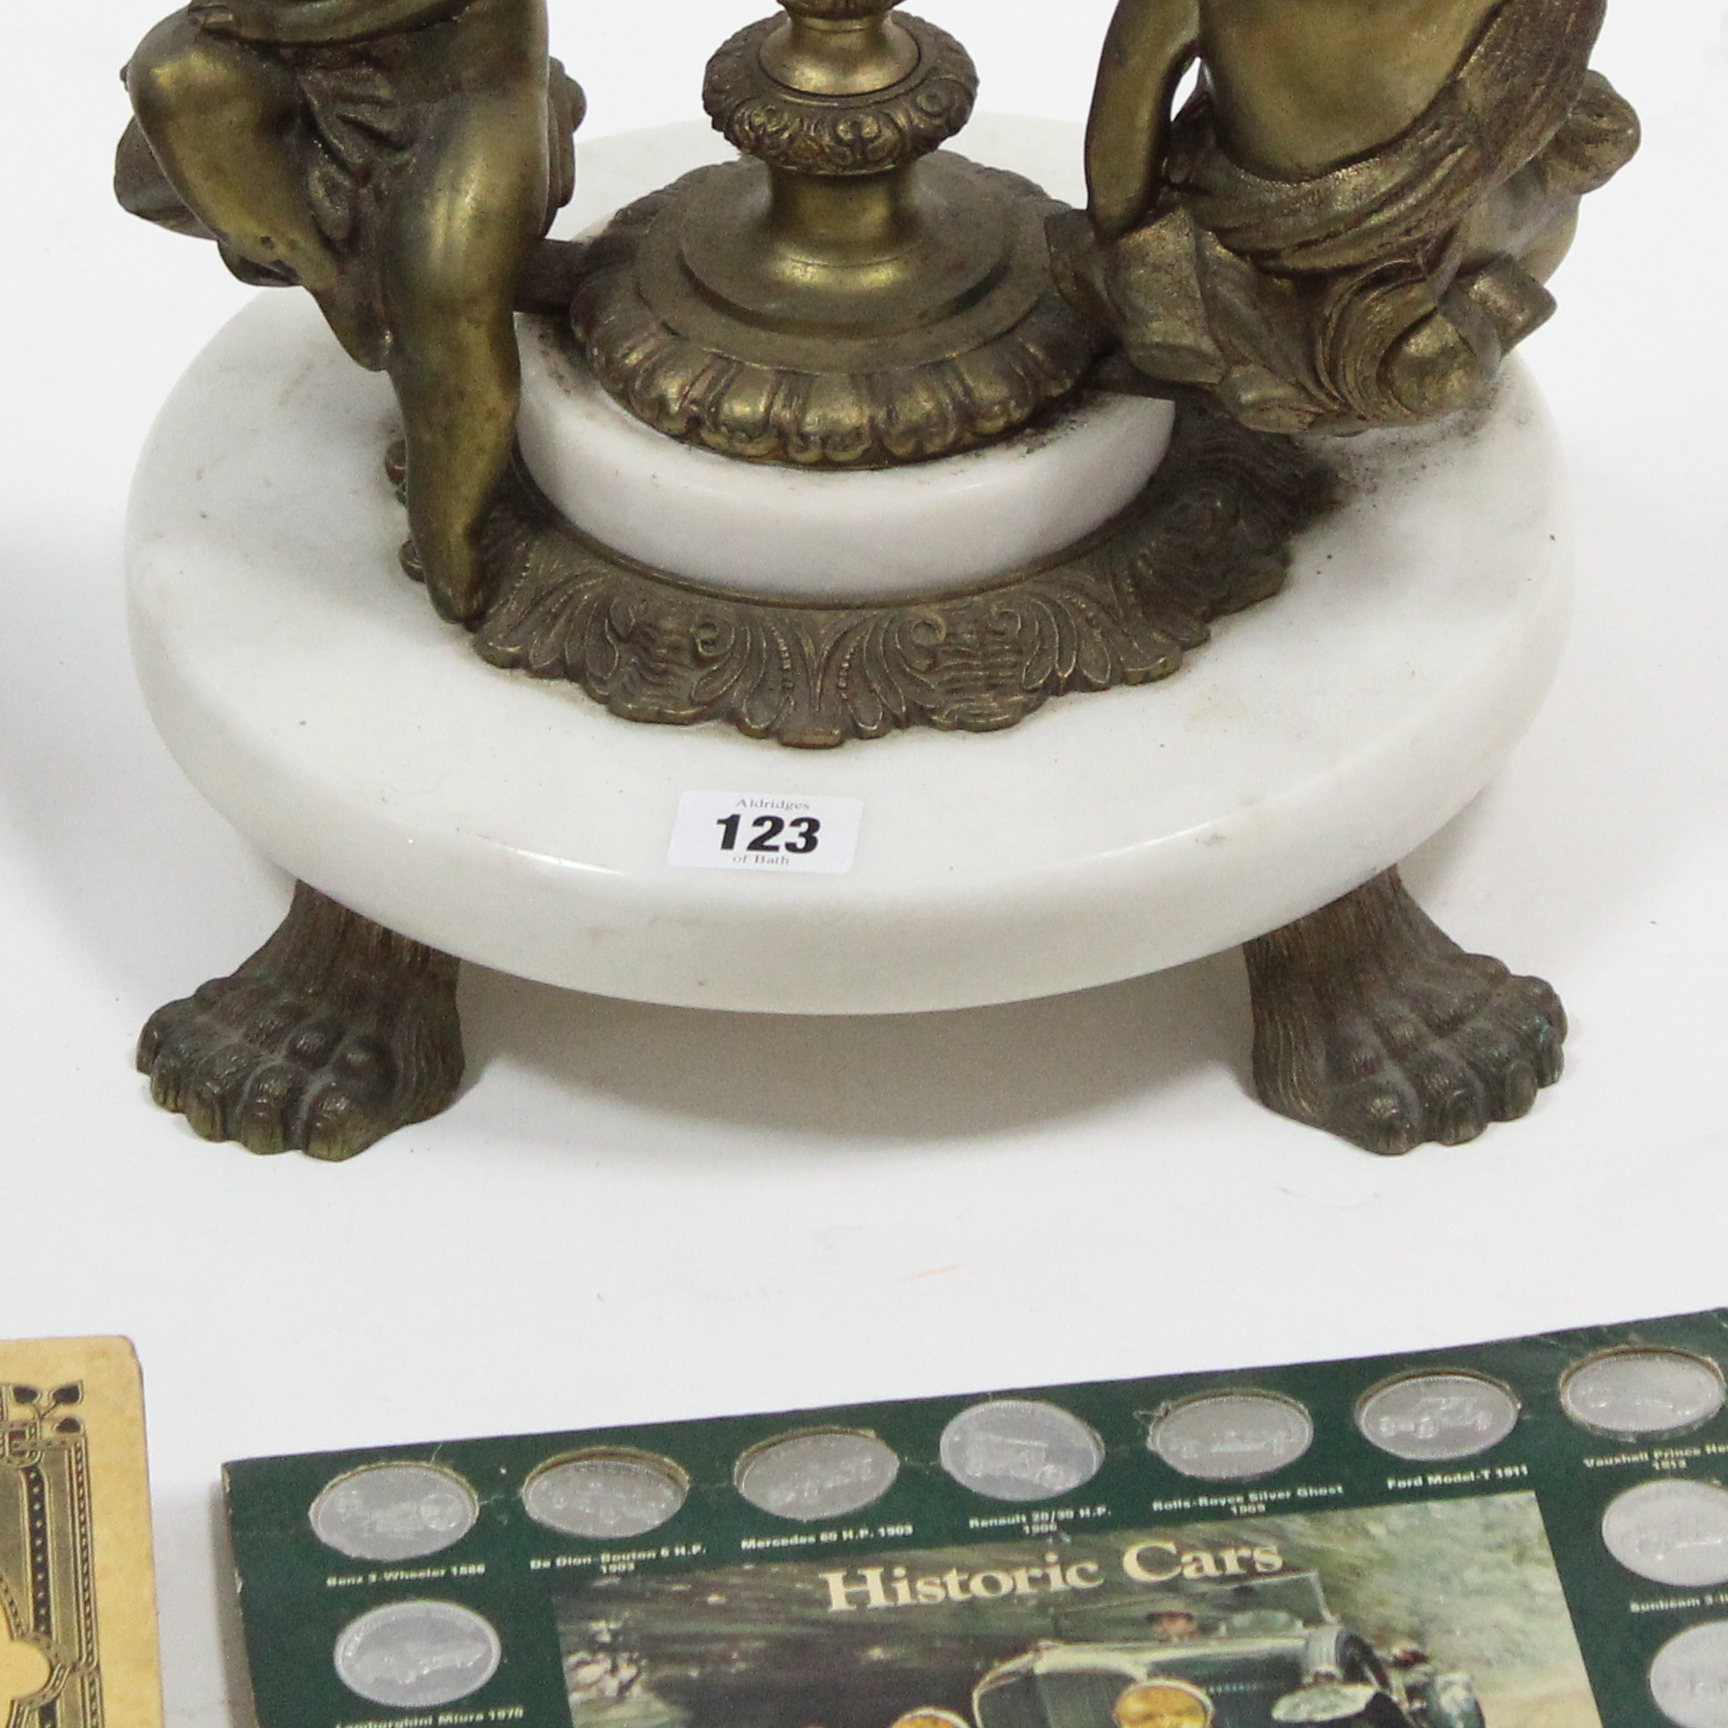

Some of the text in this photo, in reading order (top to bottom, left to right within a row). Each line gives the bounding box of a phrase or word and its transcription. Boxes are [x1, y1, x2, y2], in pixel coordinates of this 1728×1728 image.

[735, 797, 811, 812] Aldridges
[715, 813, 822, 855] 123
[732, 854, 790, 866] of Bath
[1583, 1451, 1650, 1469] Vauxhall
[1653, 1447, 1702, 1460] Prince
[1386, 1463, 1529, 1490] Ford Model-T 1911
[1152, 1483, 1344, 1512] Rolls-Royce Silver Ghost
[741, 1533, 817, 1551] Mercedes
[529, 1557, 552, 1570] De
[326, 1575, 364, 1587] Benz
[819, 1540, 1285, 1614] Historic Cars
[1629, 1597, 1702, 1613] Sunbeam
